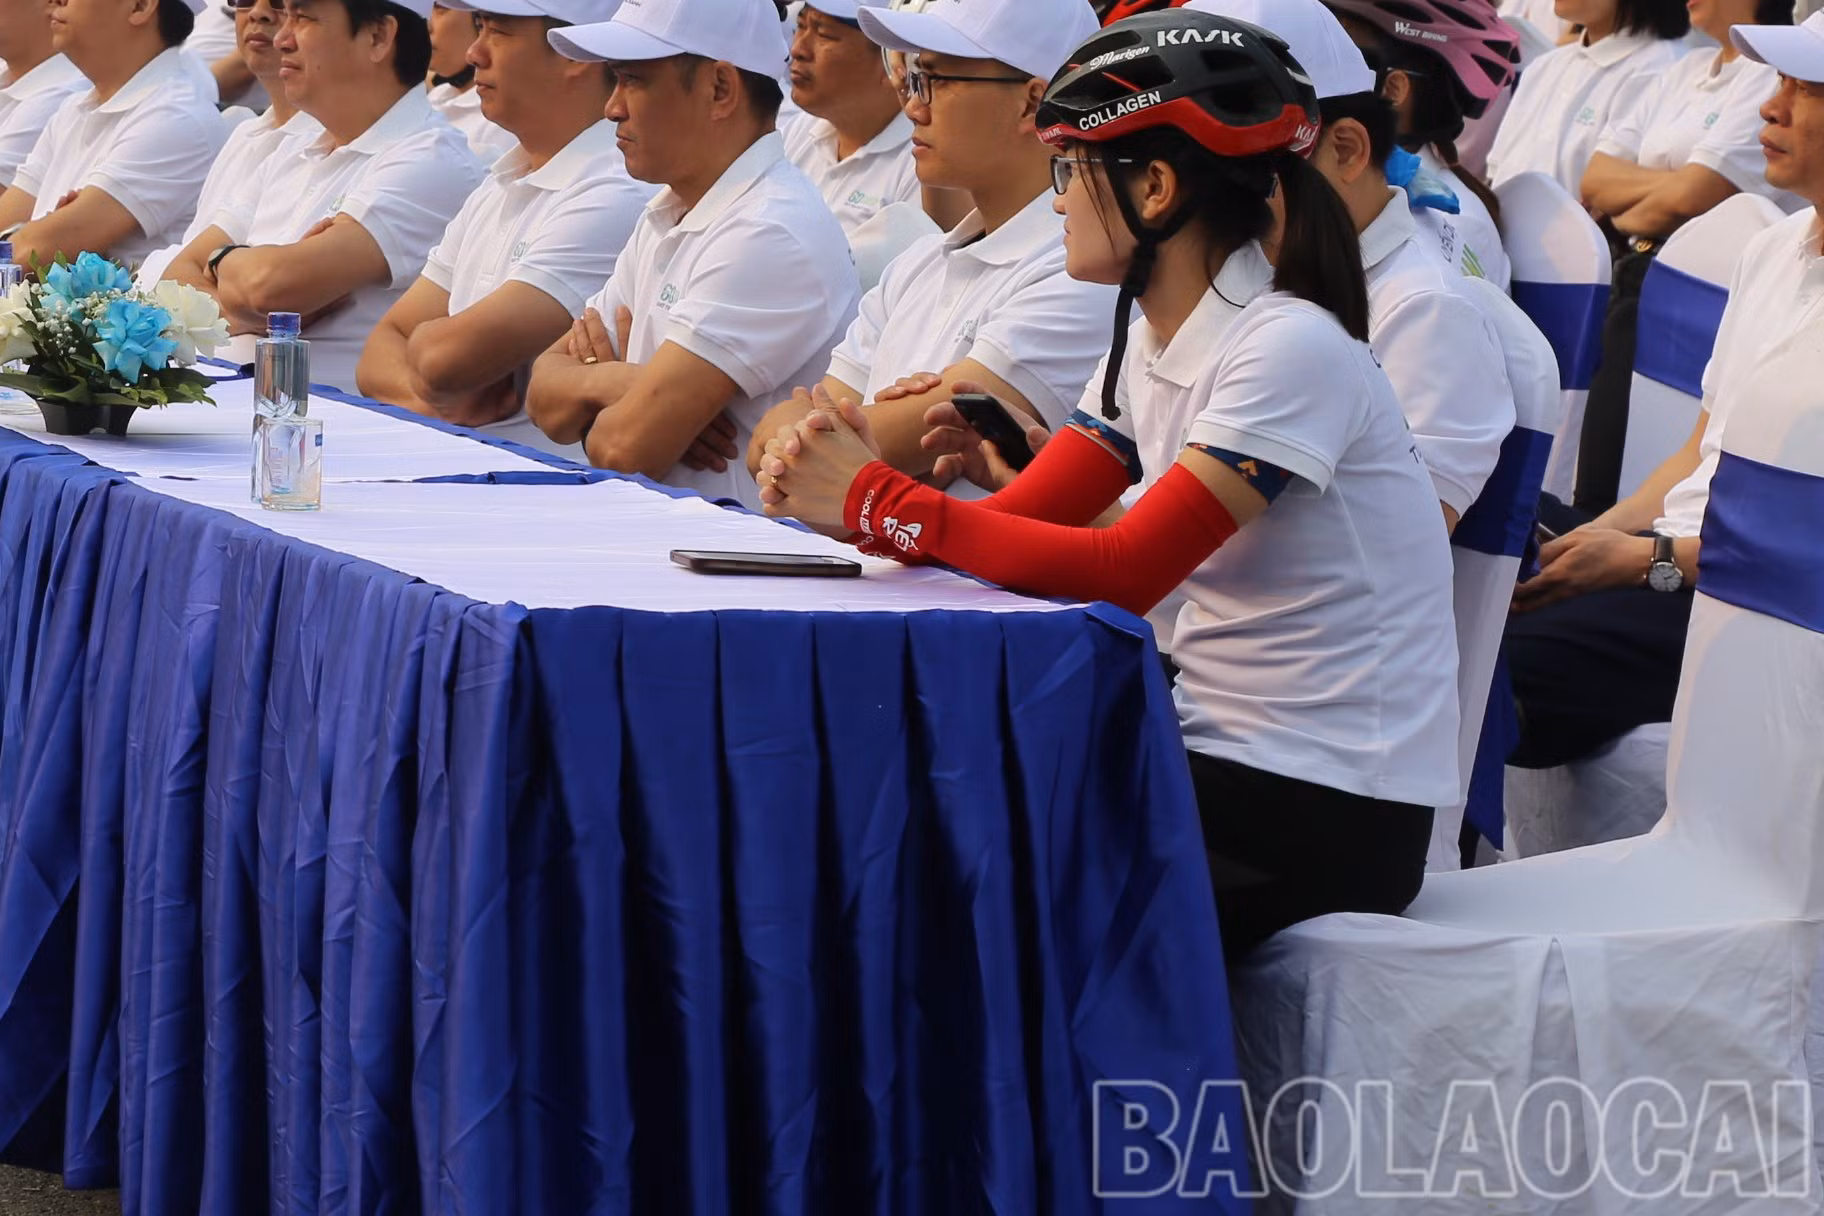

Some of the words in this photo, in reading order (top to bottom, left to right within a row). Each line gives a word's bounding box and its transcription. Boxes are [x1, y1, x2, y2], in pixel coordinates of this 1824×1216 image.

[1156, 29, 1245, 48] KASK
[1088, 44, 1151, 71] Marigen
[1078, 90, 1162, 131] COLLAGEN
